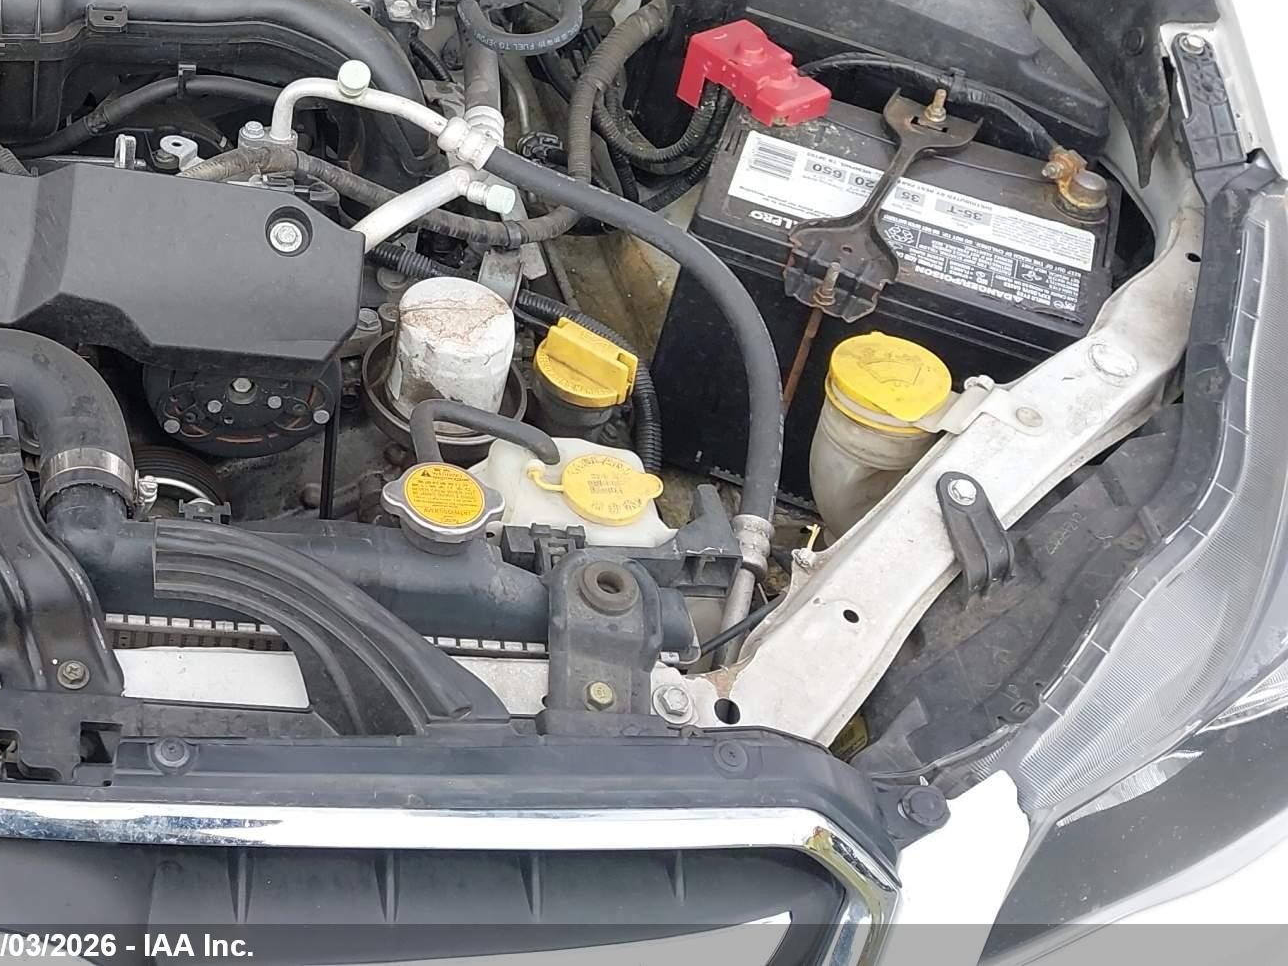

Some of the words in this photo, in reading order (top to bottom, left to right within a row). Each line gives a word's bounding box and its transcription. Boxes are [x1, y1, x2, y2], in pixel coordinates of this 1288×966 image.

[512, 42, 534, 50] FUEL
[811, 162, 842, 179] 650
[900, 190, 920, 203] 35
[946, 205, 983, 221] 35-T
